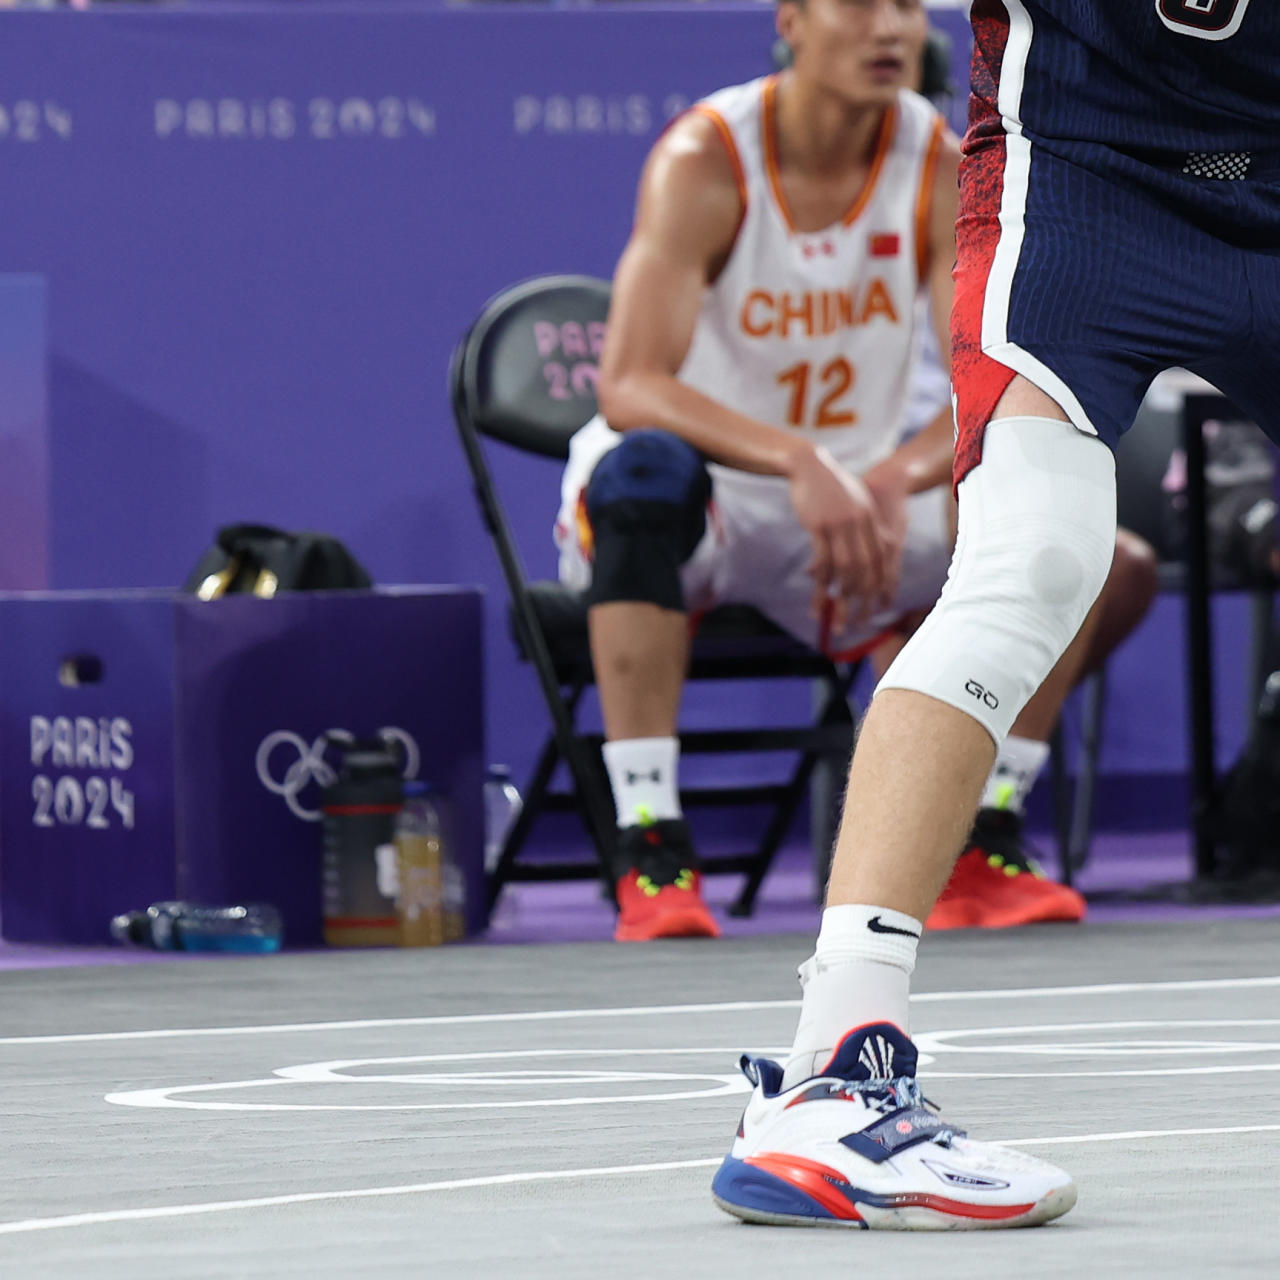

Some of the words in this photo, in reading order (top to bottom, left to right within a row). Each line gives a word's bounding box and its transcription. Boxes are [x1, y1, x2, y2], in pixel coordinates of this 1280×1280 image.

[739, 279, 902, 340] CHINA
[533, 320, 608, 357] PAR
[544, 360, 600, 401] 20
[777, 354, 858, 428] 12
[32, 775, 134, 828] 2024
